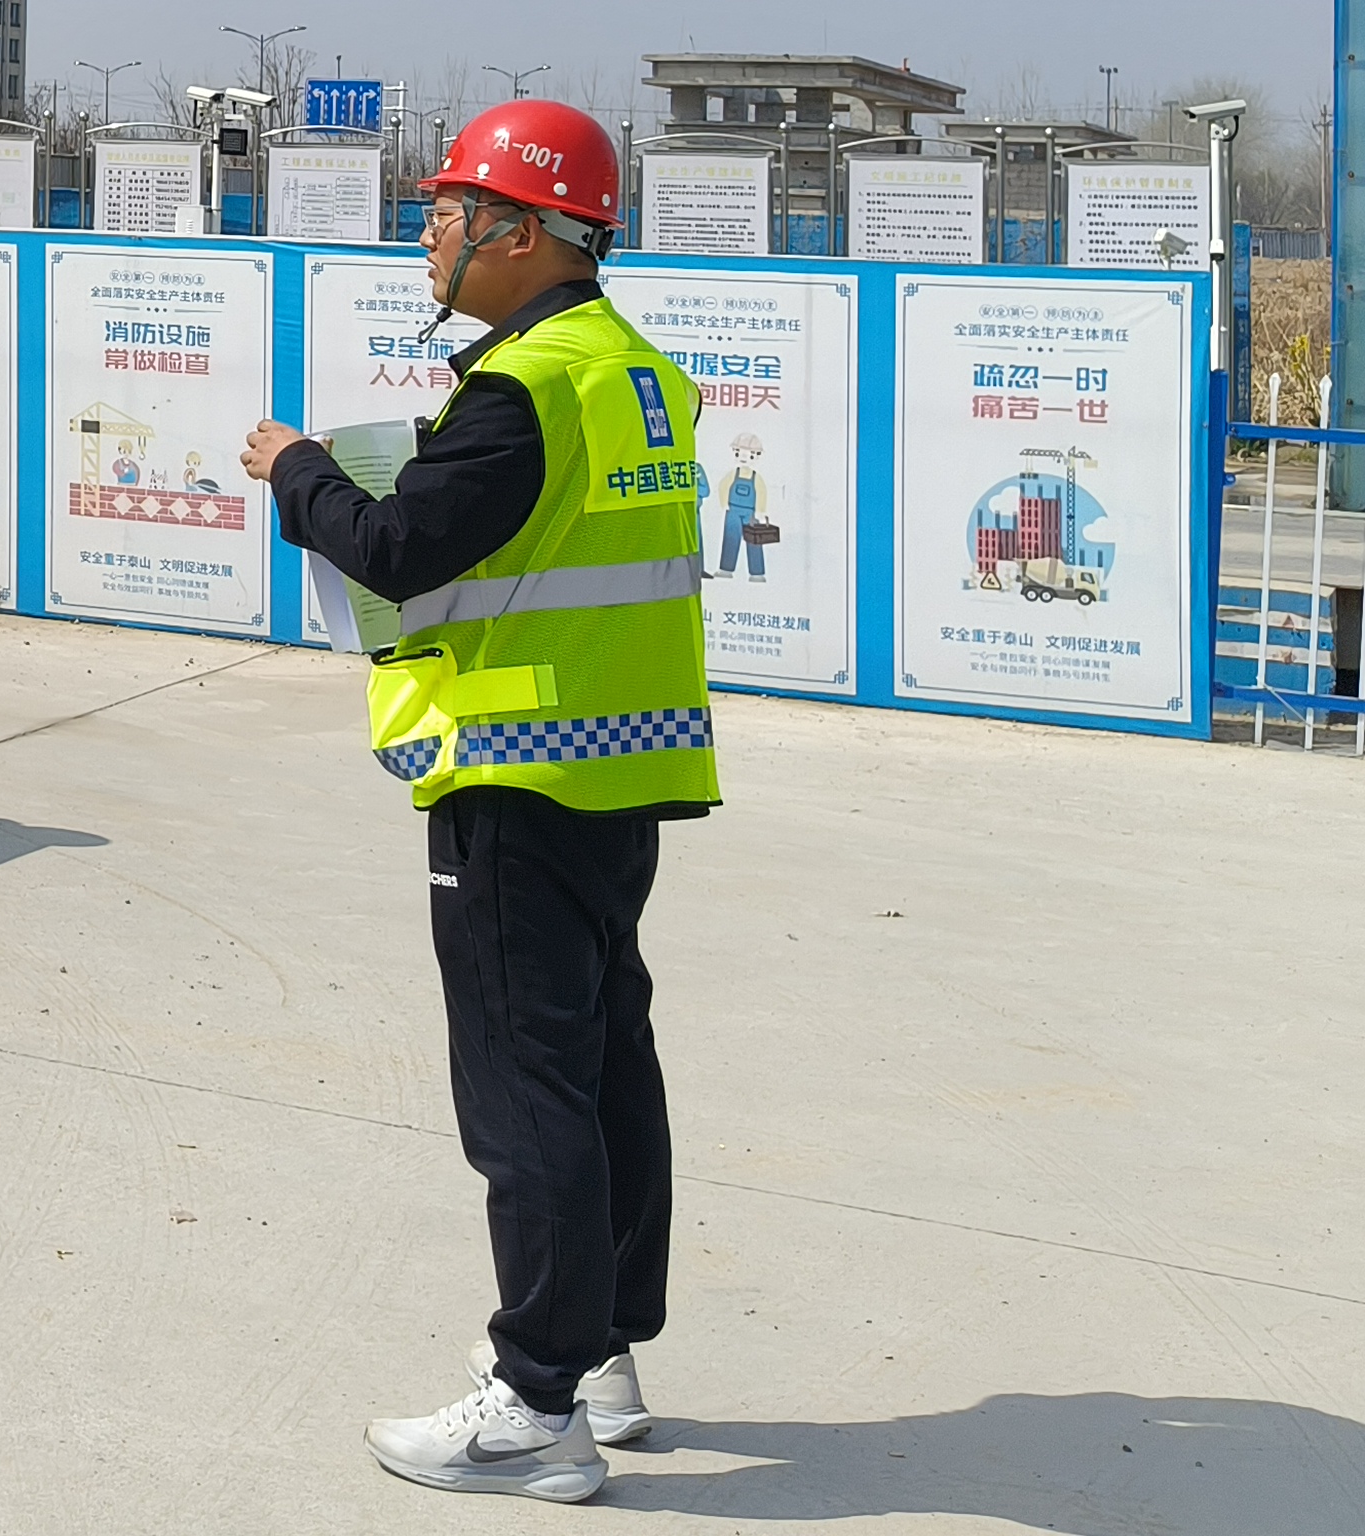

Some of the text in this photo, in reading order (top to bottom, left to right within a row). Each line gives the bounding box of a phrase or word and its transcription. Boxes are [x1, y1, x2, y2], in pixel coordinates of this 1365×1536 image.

[493, 127, 564, 175] A-001
[91, 286, 225, 303] 全面落实安全生产主体责任
[354, 299, 443, 313] 全面落实安全生
[105, 321, 211, 348] 消防设施
[641, 312, 802, 331] 全面落实安全生产主体责任
[954, 323, 1129, 342] 全面落实安全生产主体责任
[105, 348, 210, 375] 常做检查
[973, 363, 1108, 392] 疏忽一时
[972, 395, 1109, 424] 痛苦一世
[80, 551, 233, 577] 安全重于泰山 文明促进发展
[723, 611, 810, 632] 文明促进发展
[940, 626, 1141, 656] 安全重于泰山 文明促进发展
